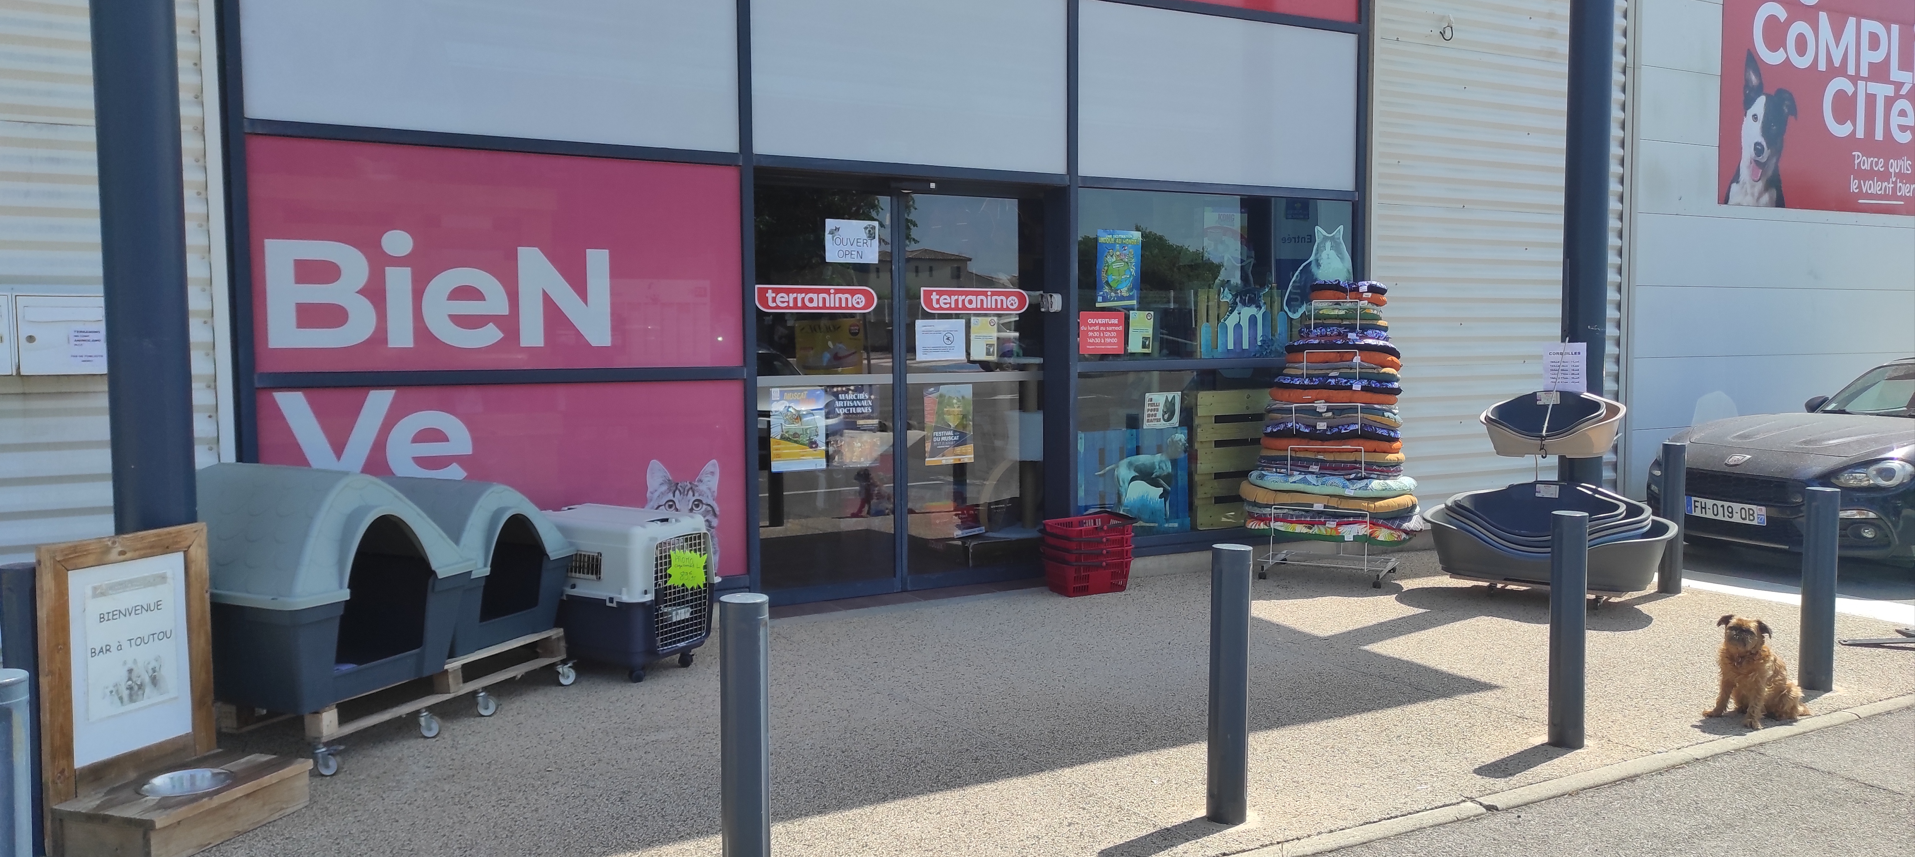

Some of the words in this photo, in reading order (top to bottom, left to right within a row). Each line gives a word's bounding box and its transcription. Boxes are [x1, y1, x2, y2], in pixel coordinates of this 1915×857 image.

[1753, 1, 1915, 84] CoMPL
[1823, 77, 1915, 144] CITé
[1852, 151, 1885, 172] Parce
[1850, 175, 1859, 193] le
[1860, 178, 1895, 196] valent
[834, 236, 873, 248] OUVERT
[837, 249, 863, 260] OPEN
[264, 229, 612, 349] BieN
[766, 289, 865, 308] terranimo
[931, 291, 1019, 309] terranimo
[98, 600, 163, 623] BIENVENUE
[90, 644, 112, 658] BAR
[116, 641, 123, 651] à
[126, 629, 173, 648] TOUTOU
